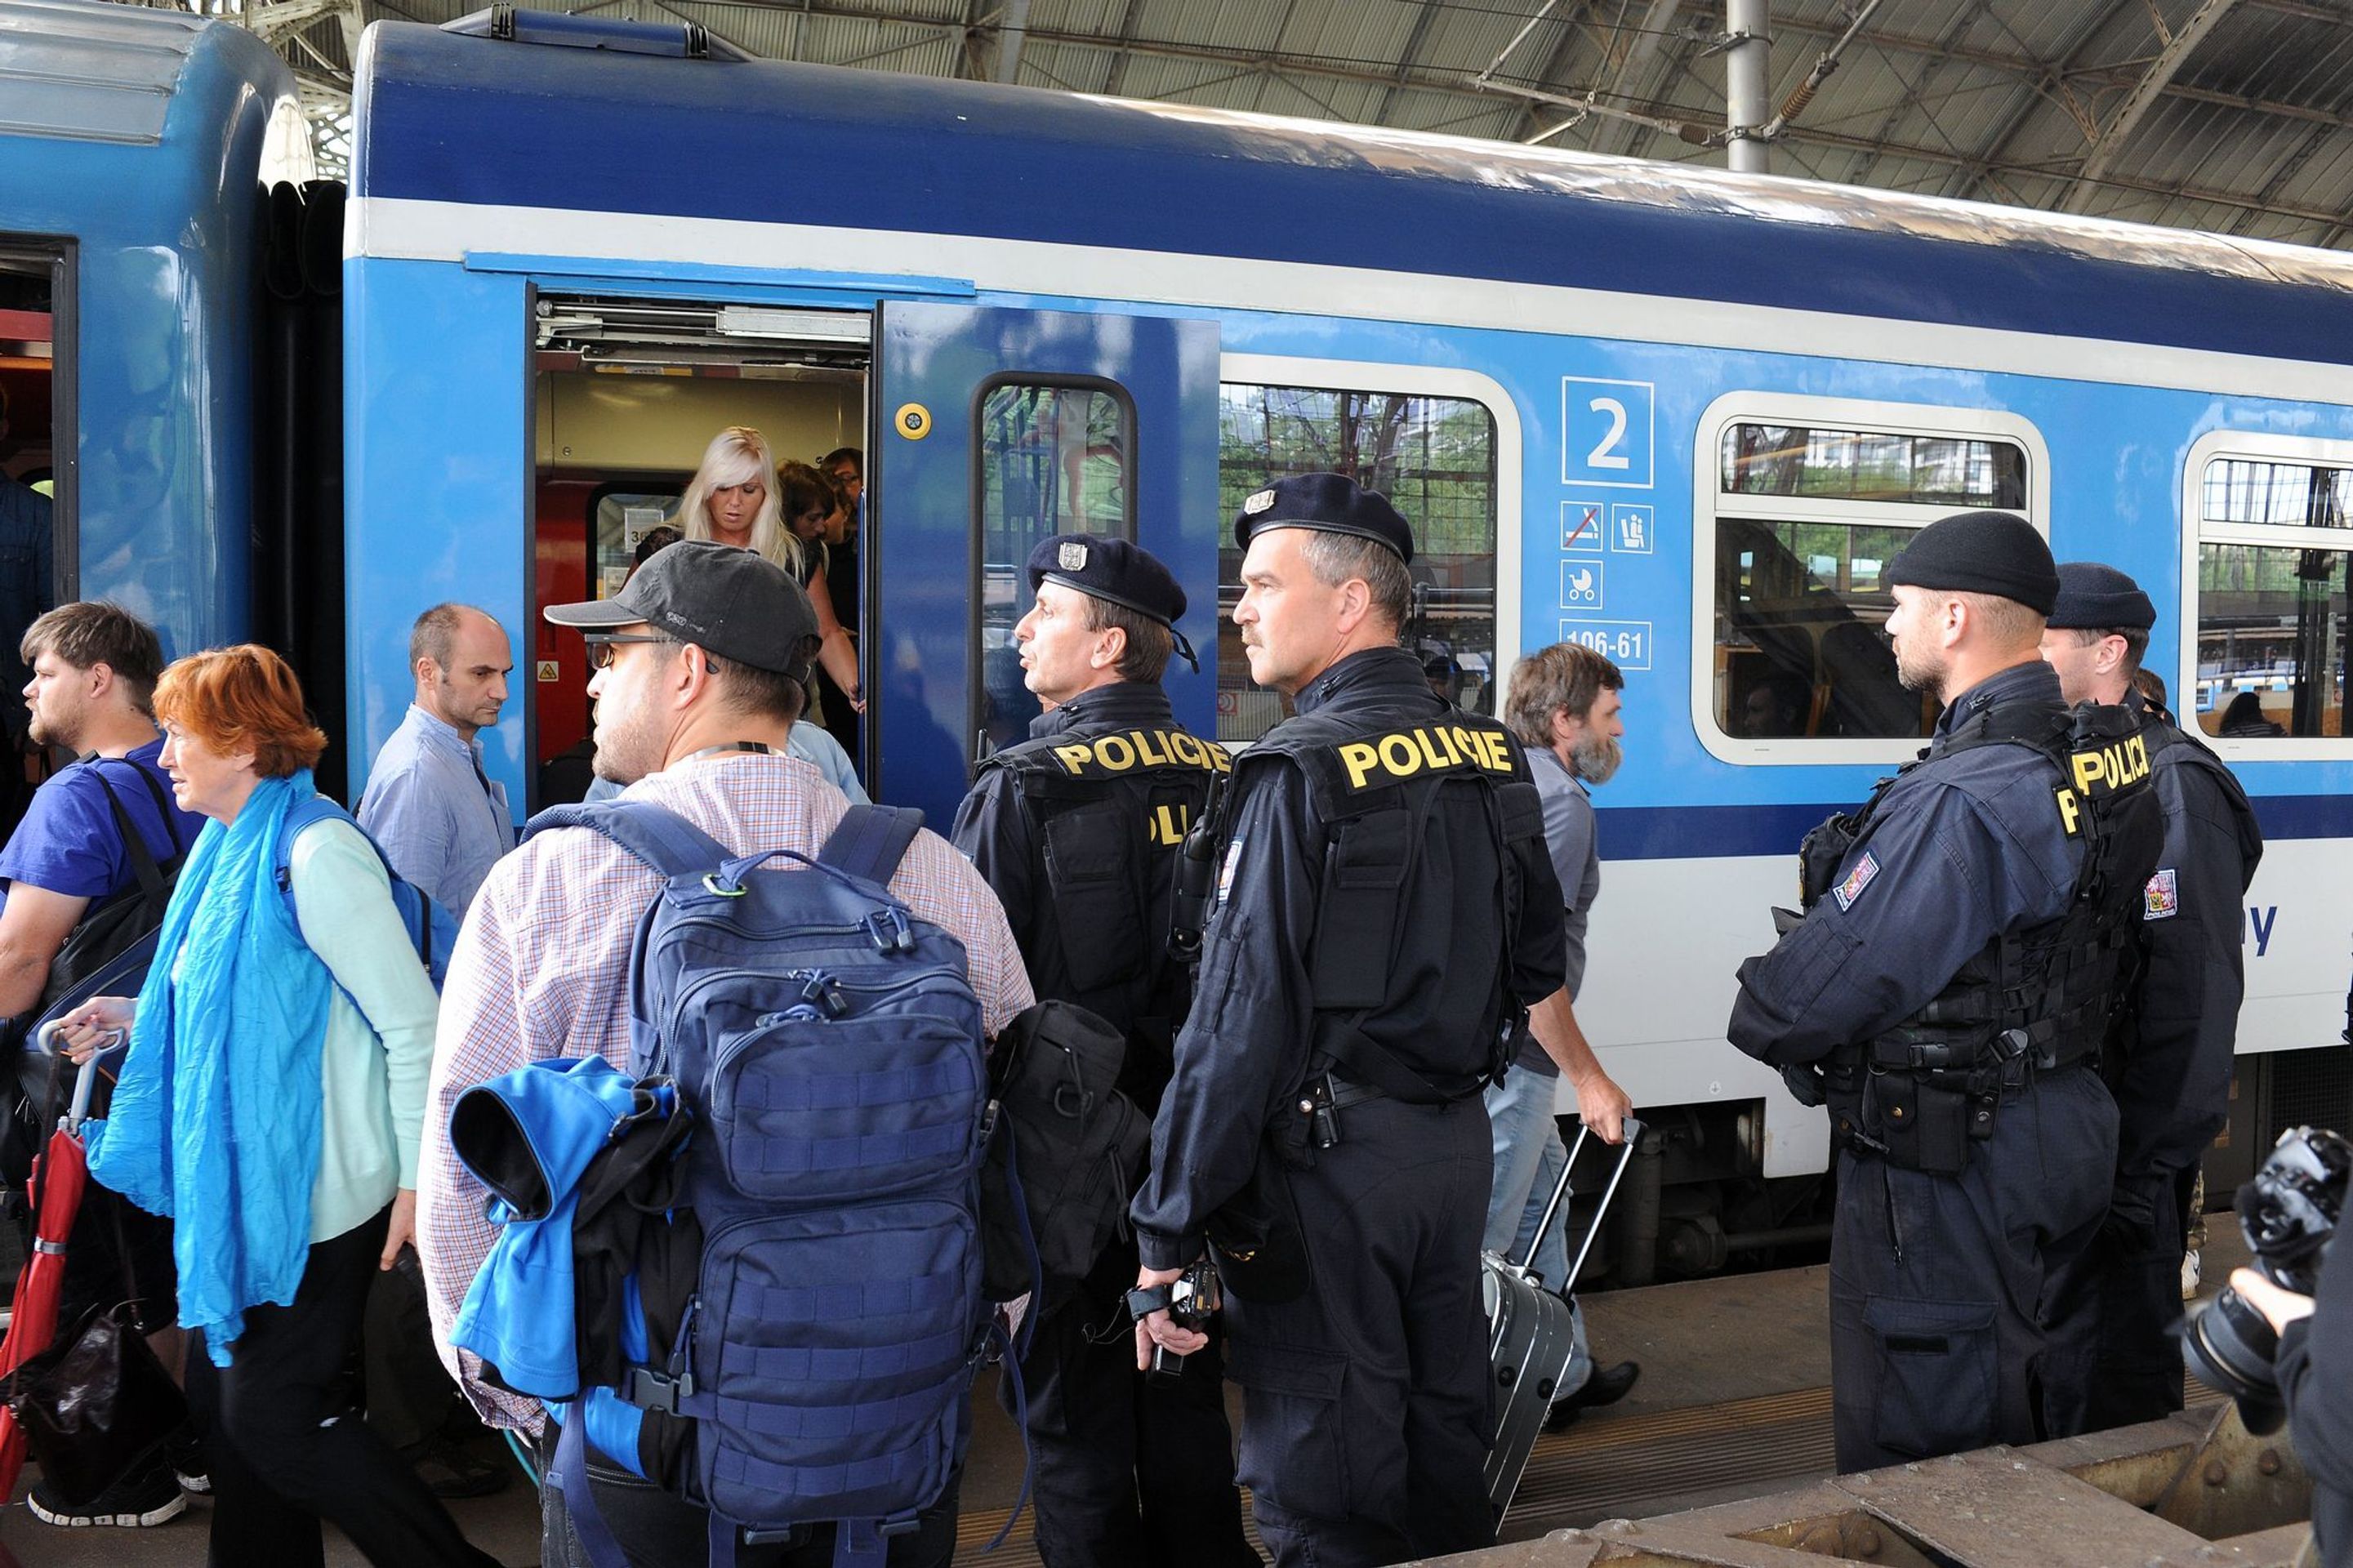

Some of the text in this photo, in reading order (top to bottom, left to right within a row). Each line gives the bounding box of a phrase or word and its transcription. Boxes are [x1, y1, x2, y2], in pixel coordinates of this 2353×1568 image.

[1587, 397, 1629, 470] 2
[1054, 730, 1232, 775] POLICIE
[1338, 726, 1512, 789] POLICIE
[2241, 906, 2278, 957] y
